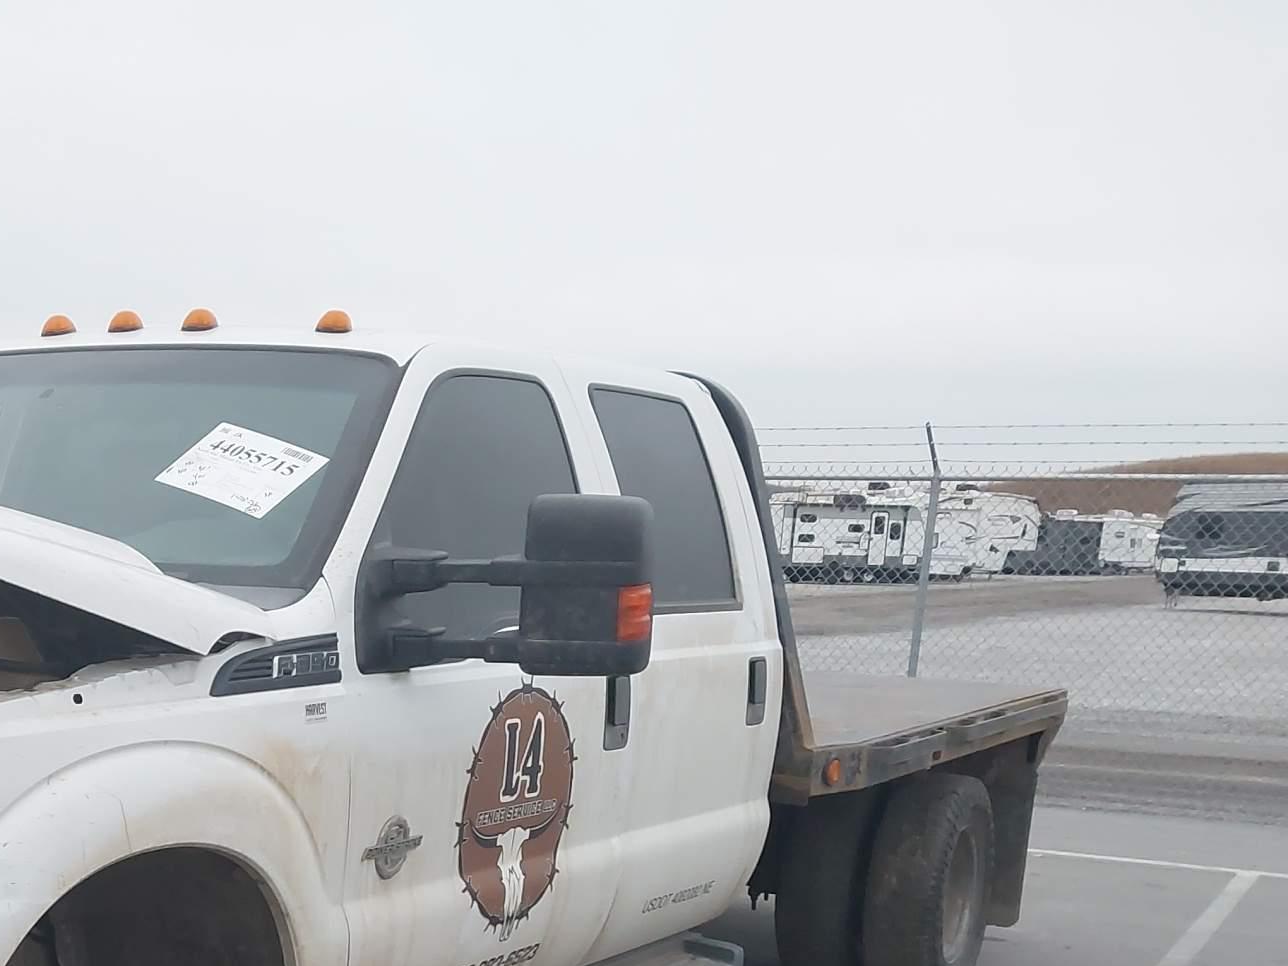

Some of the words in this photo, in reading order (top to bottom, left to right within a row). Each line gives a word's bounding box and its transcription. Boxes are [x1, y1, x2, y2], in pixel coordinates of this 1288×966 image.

[209, 439, 300, 477] 44055715
[476, 806, 507, 829] FENCE
[505, 800, 544, 822] SERVICE
